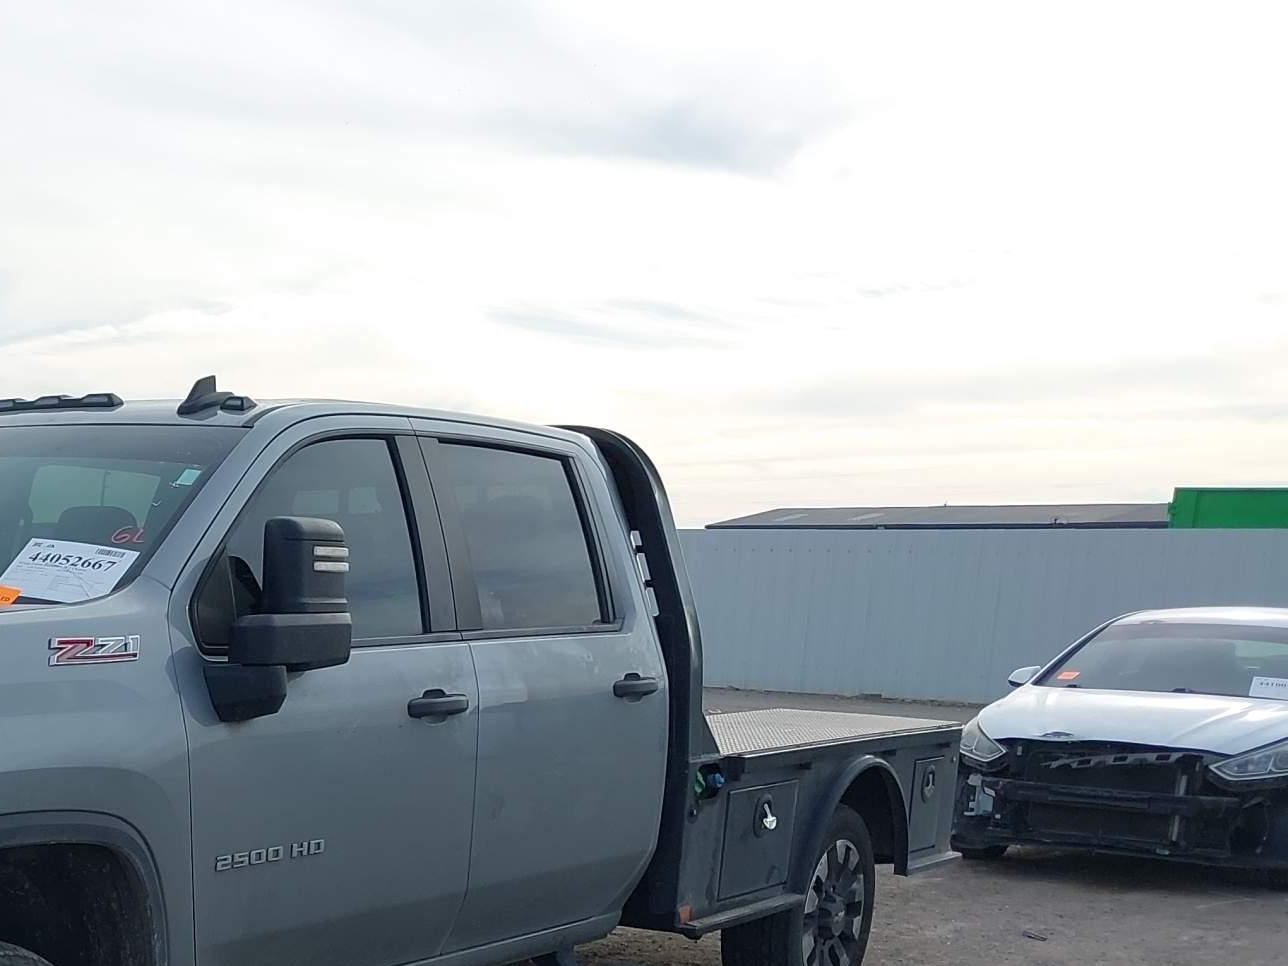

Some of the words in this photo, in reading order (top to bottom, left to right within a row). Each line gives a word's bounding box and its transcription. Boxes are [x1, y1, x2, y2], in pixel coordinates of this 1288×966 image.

[27, 549, 118, 572] 44052667
[48, 634, 141, 667] Z71
[215, 846, 284, 871] 2500
[290, 839, 325, 858] HD
